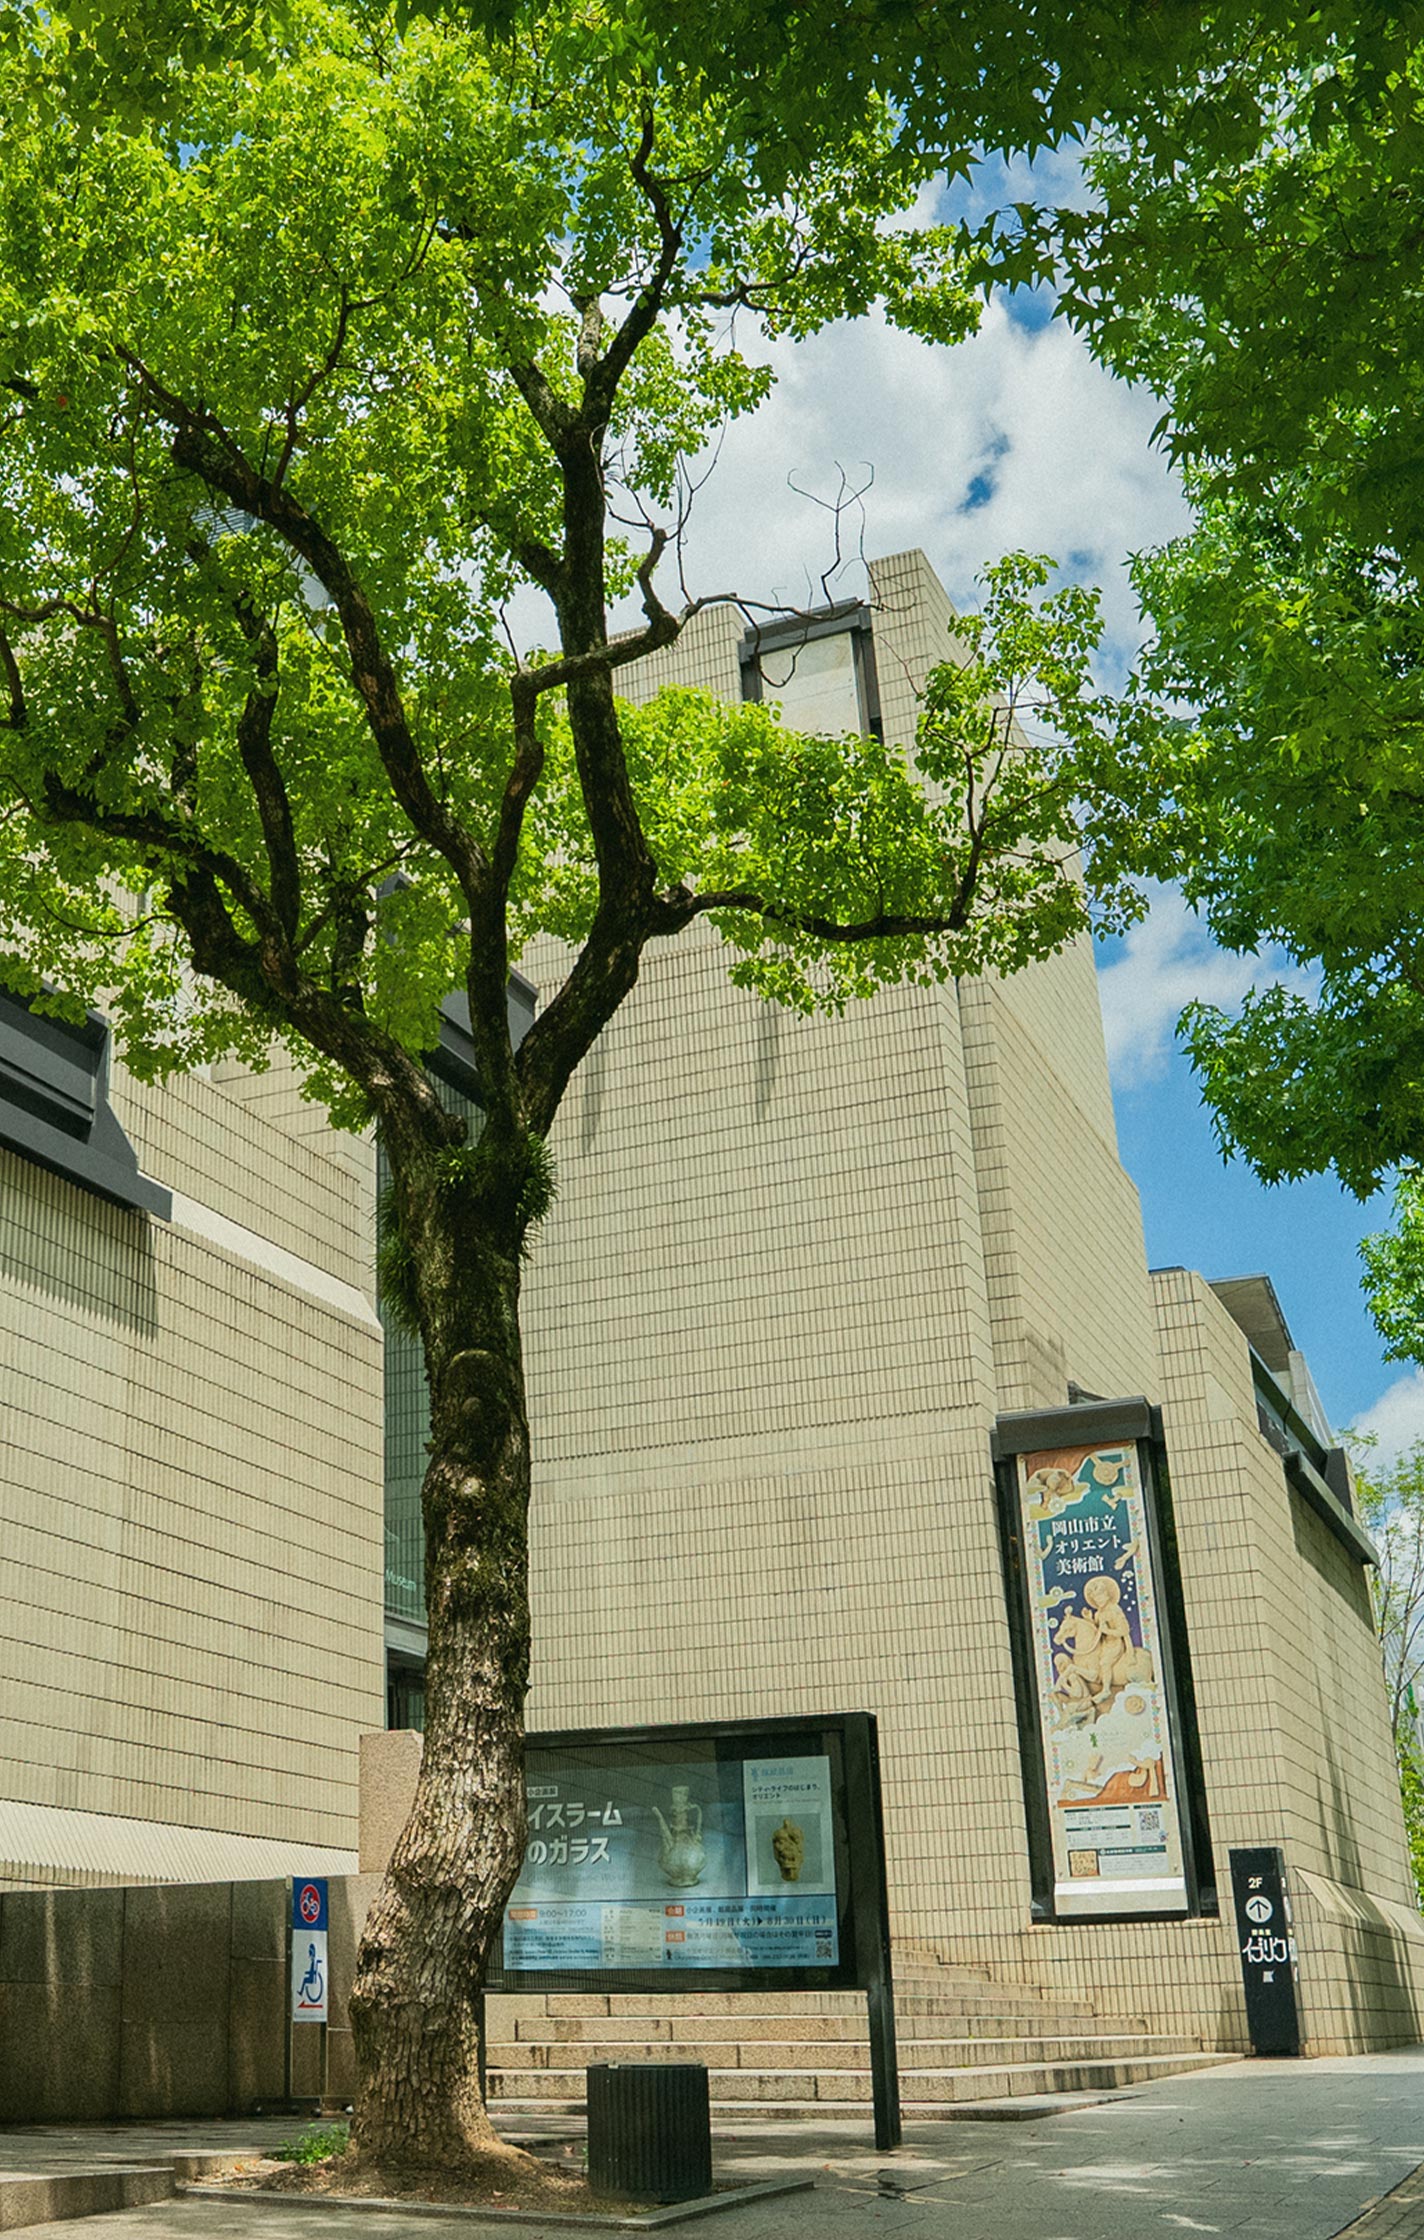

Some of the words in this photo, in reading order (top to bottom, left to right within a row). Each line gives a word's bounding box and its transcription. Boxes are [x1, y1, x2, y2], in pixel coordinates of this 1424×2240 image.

[1052, 1515, 1117, 1536] 岡山市立
[1055, 1535, 1121, 1554] オリエント
[1056, 1555, 1104, 1576] 美術館
[527, 1801, 623, 1830] イスラーム
[527, 1835, 611, 1864] のガラス
[1248, 1877, 1263, 1889] 2F
